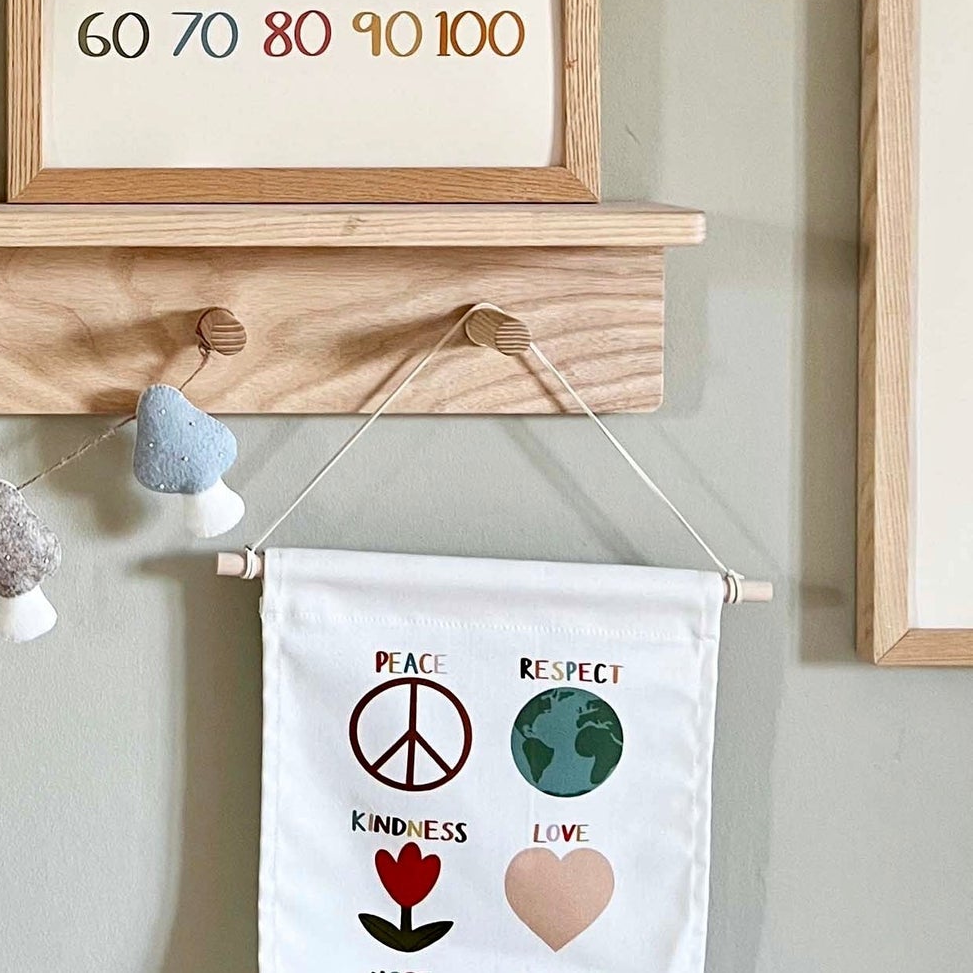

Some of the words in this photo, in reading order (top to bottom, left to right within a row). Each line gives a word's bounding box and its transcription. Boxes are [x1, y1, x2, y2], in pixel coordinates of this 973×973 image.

[77, 11, 151, 59] 60
[170, 11, 239, 59] 70
[262, 9, 333, 58] 80
[351, 10, 423, 58] 90
[434, 9, 526, 58] 100
[375, 650, 448, 675] PEACE
[520, 657, 624, 684] RESPECT
[350, 810, 469, 843] KINDNESS
[532, 823, 590, 844] LOVE
